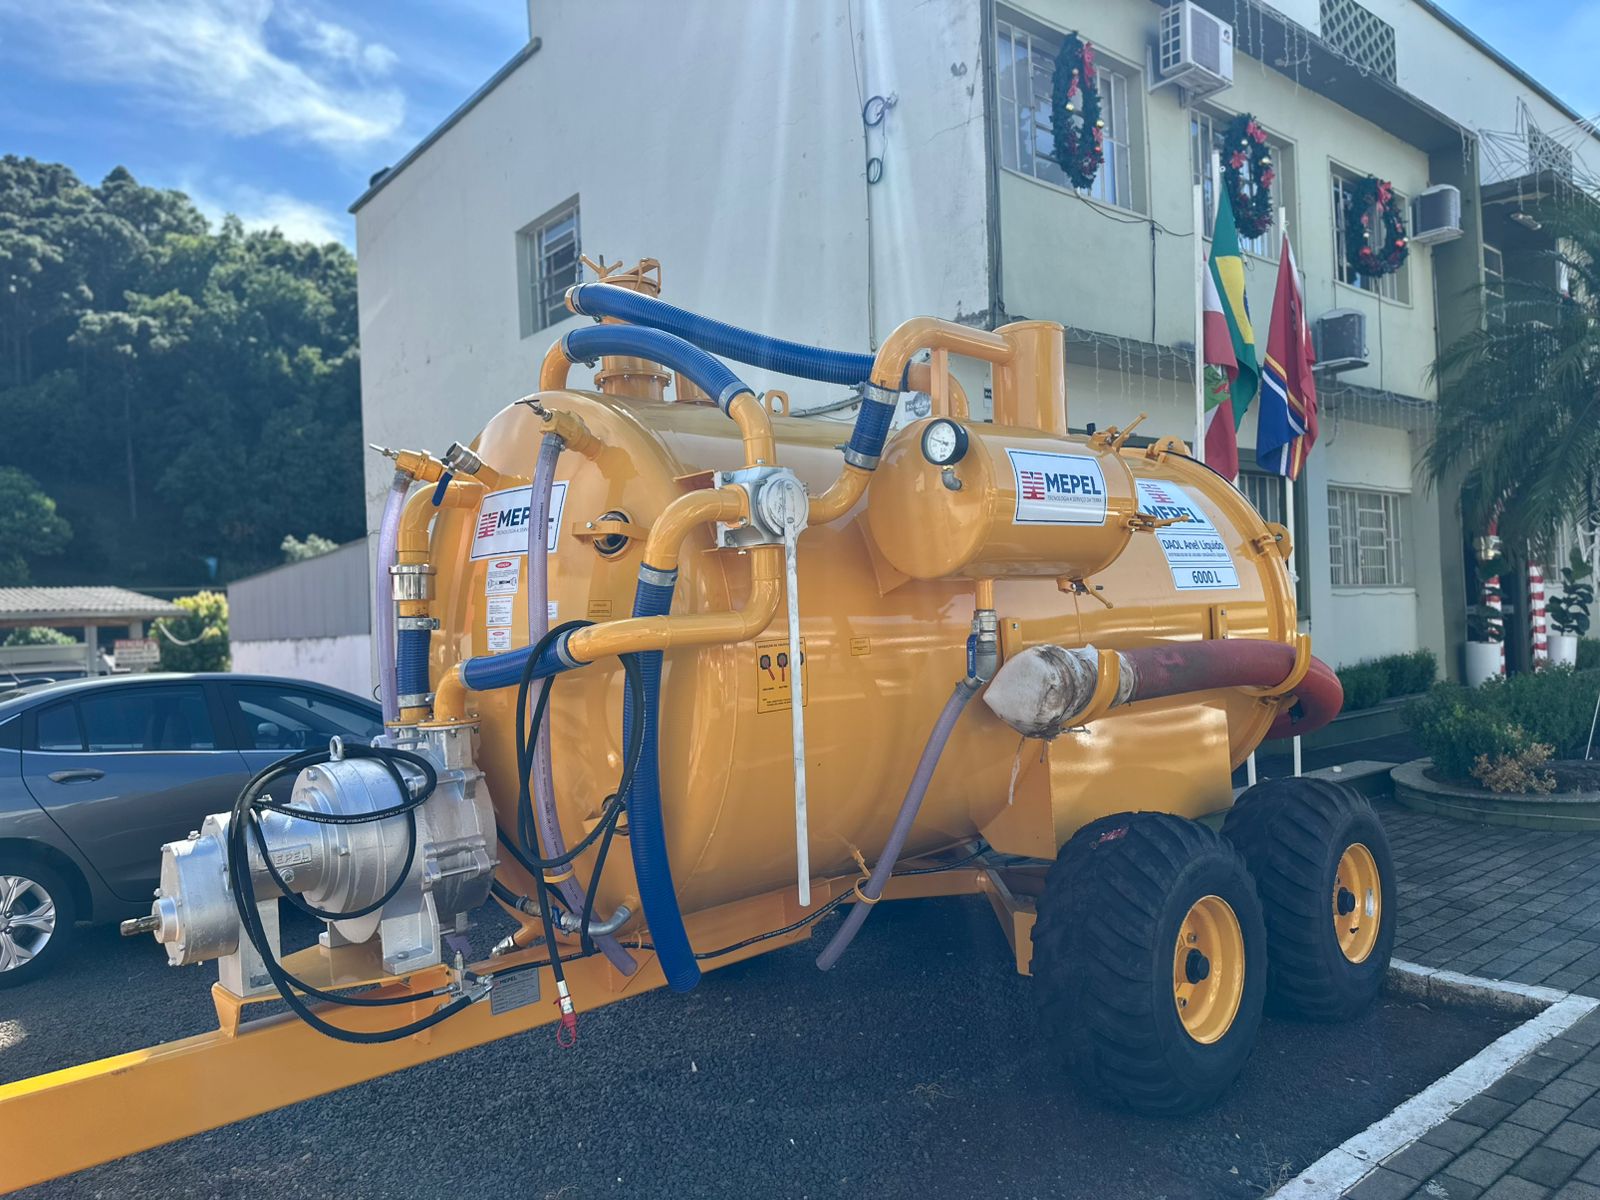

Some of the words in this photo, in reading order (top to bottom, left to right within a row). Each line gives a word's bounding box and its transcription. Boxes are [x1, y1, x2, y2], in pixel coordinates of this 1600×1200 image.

[1045, 472, 1102, 495] MEPEL
[1162, 539, 1184, 550] DAOL
[1184, 539, 1200, 550] Anel
[1192, 570, 1214, 584] 6000
[1214, 571, 1221, 583] L
